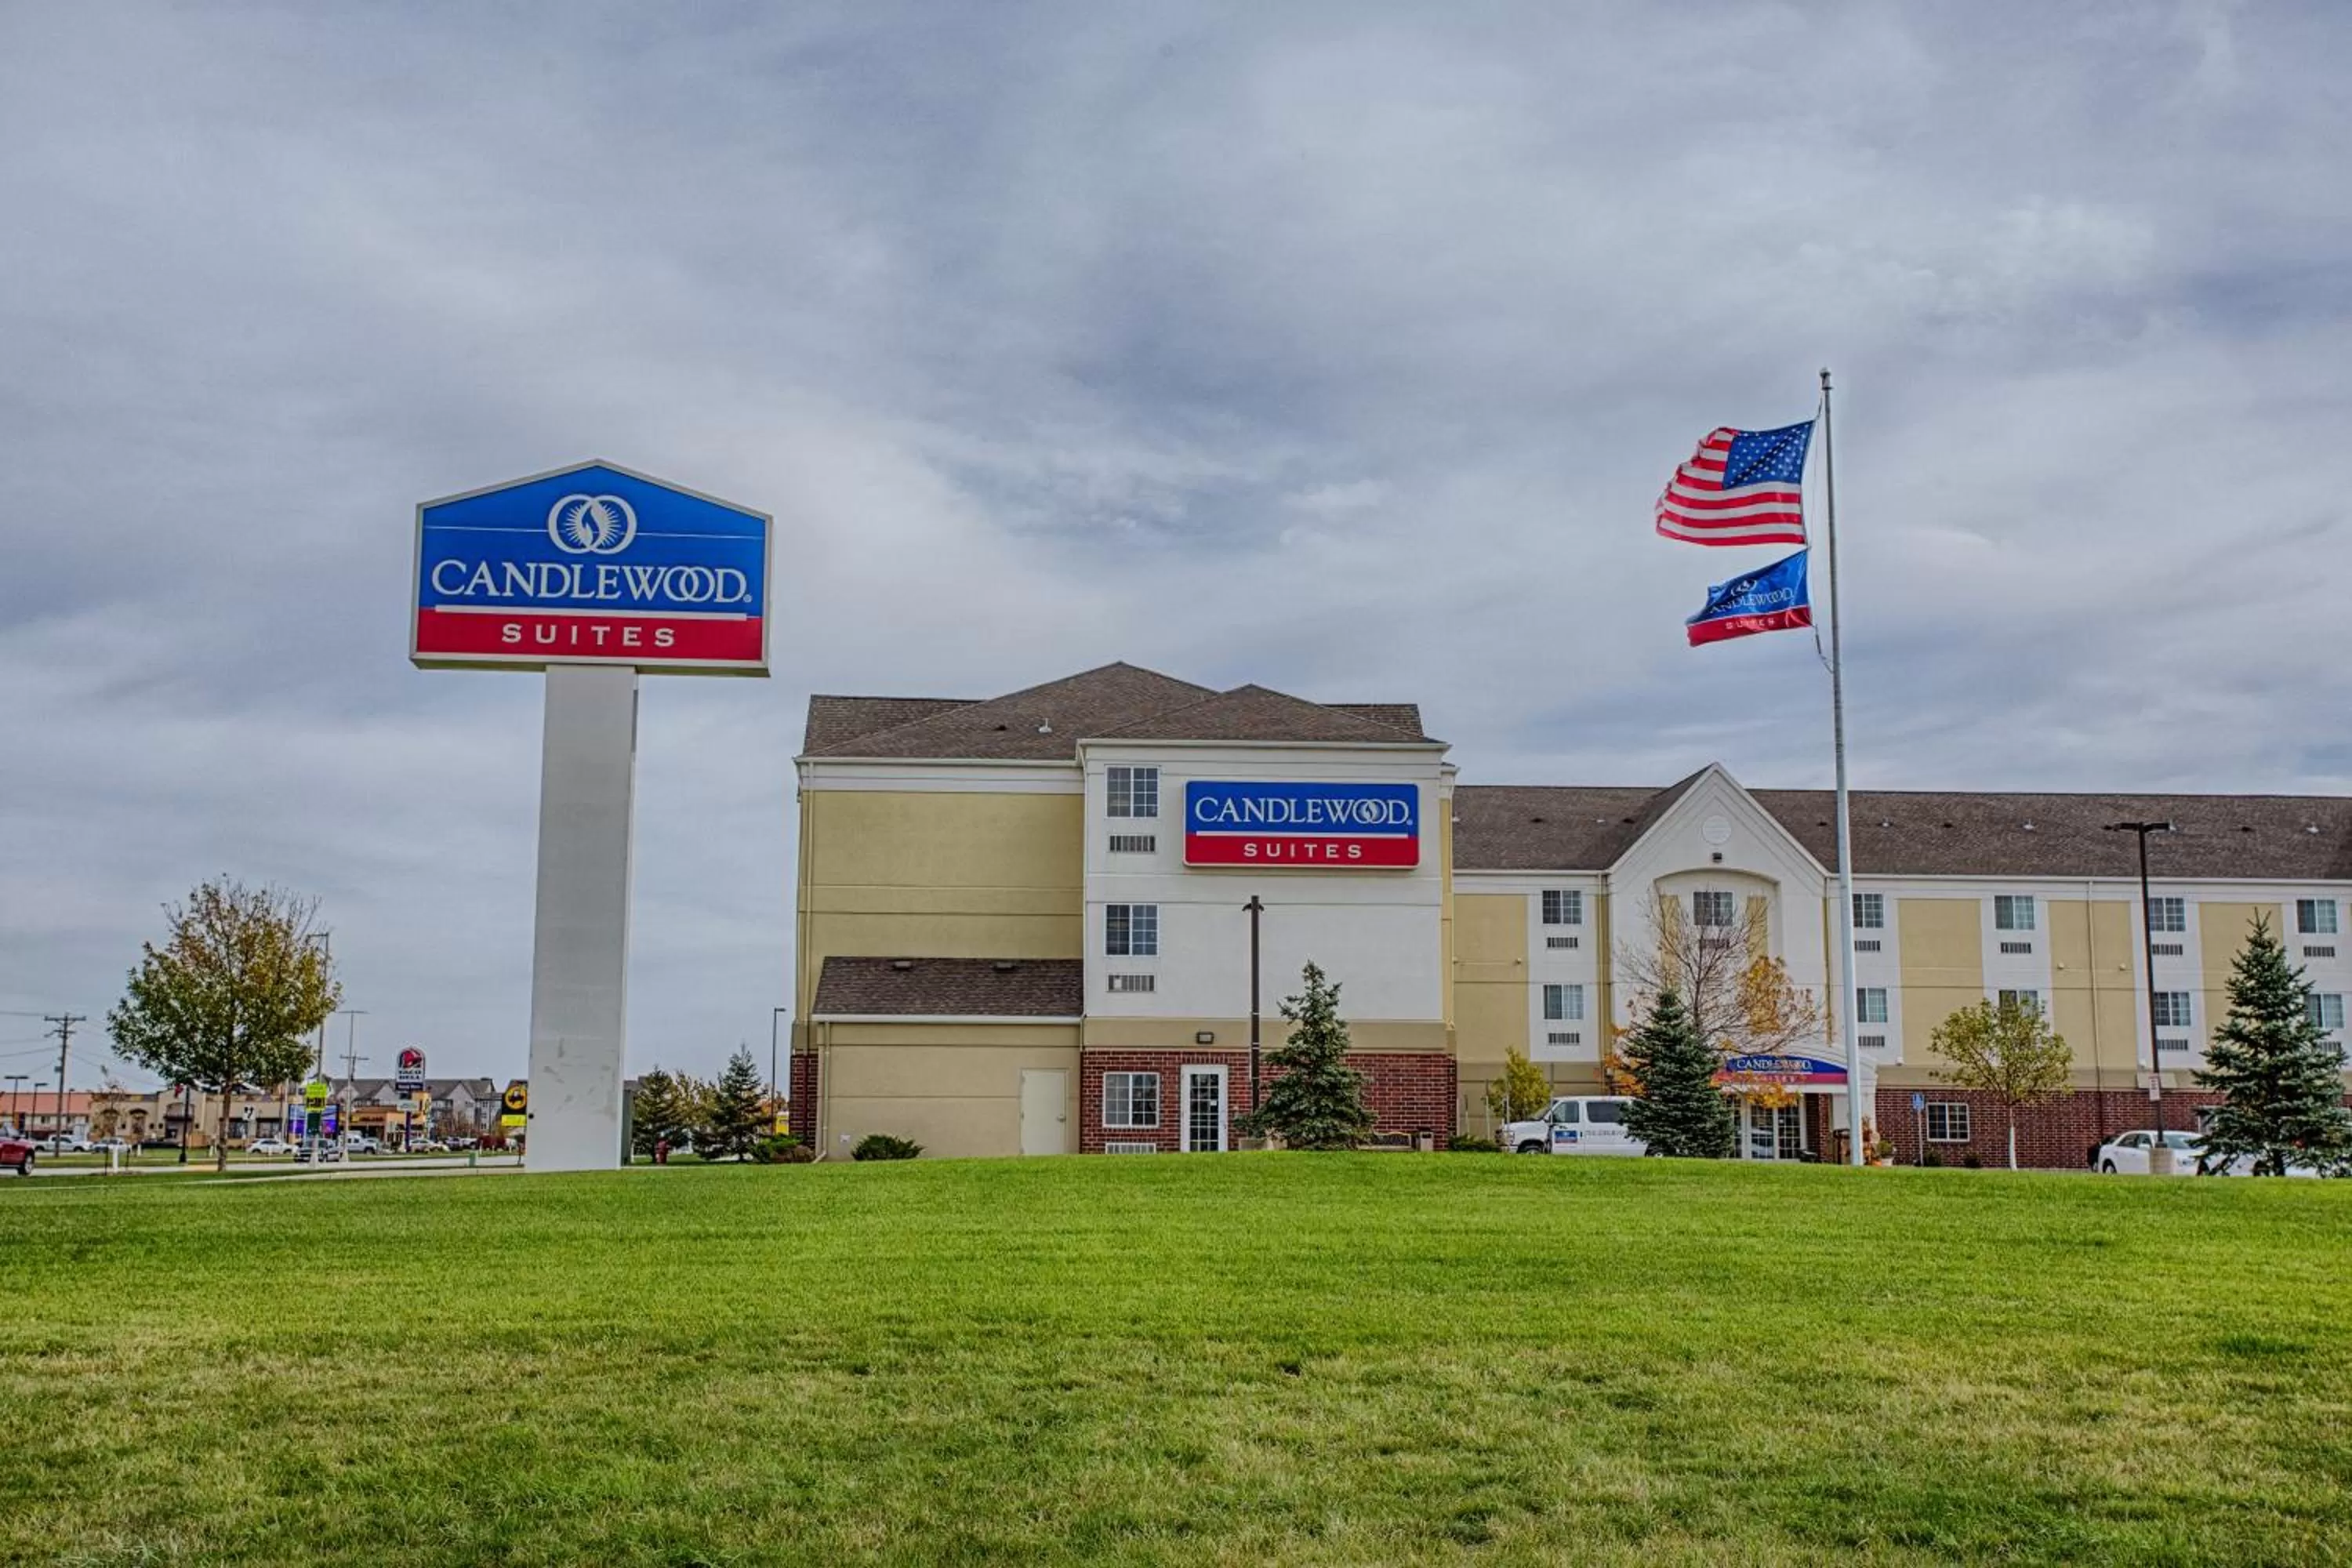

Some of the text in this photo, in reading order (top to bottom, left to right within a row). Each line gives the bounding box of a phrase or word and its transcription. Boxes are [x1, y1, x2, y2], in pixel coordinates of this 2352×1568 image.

[431, 559, 746, 603] CANDLEWOOD
[1709, 586, 1794, 614] ANDLEWOOD
[501, 623, 675, 647] SUITES
[1195, 797, 1409, 824] CANDLEWOOD
[1243, 843, 1363, 858] SUITES
